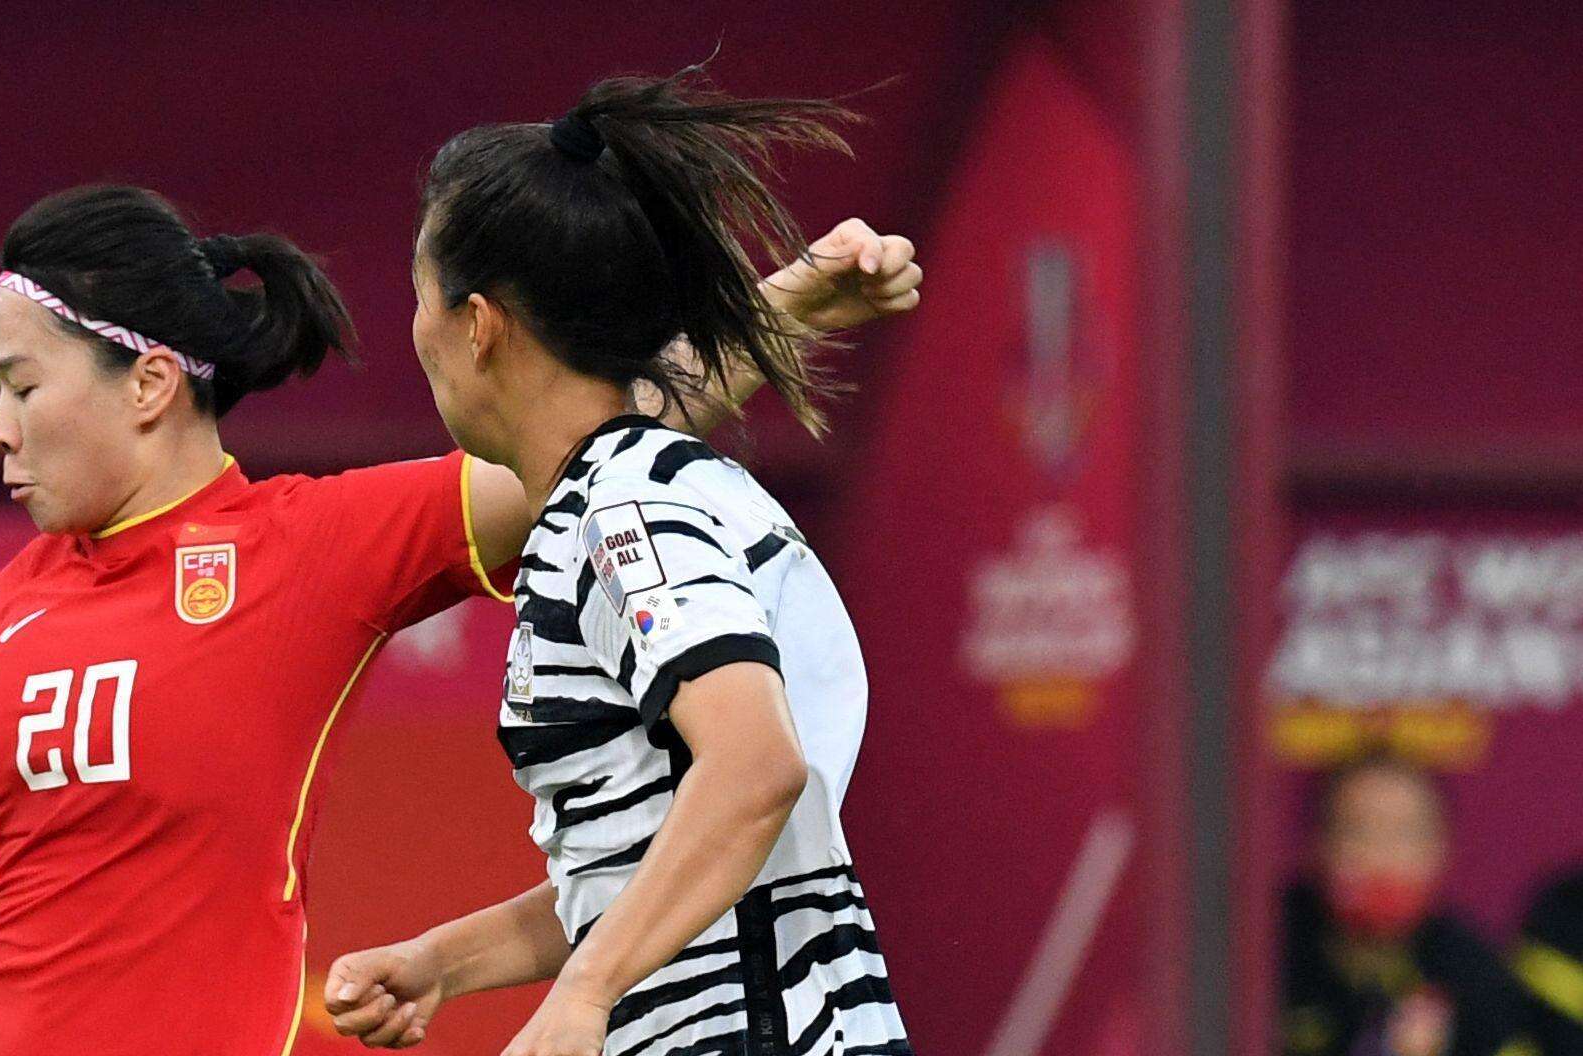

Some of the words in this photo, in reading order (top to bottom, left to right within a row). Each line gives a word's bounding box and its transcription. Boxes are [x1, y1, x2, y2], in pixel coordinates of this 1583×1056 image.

[605, 528, 642, 550] GOAL
[184, 552, 228, 570] CFA
[617, 547, 643, 567] ALL
[17, 660, 138, 791] 20
